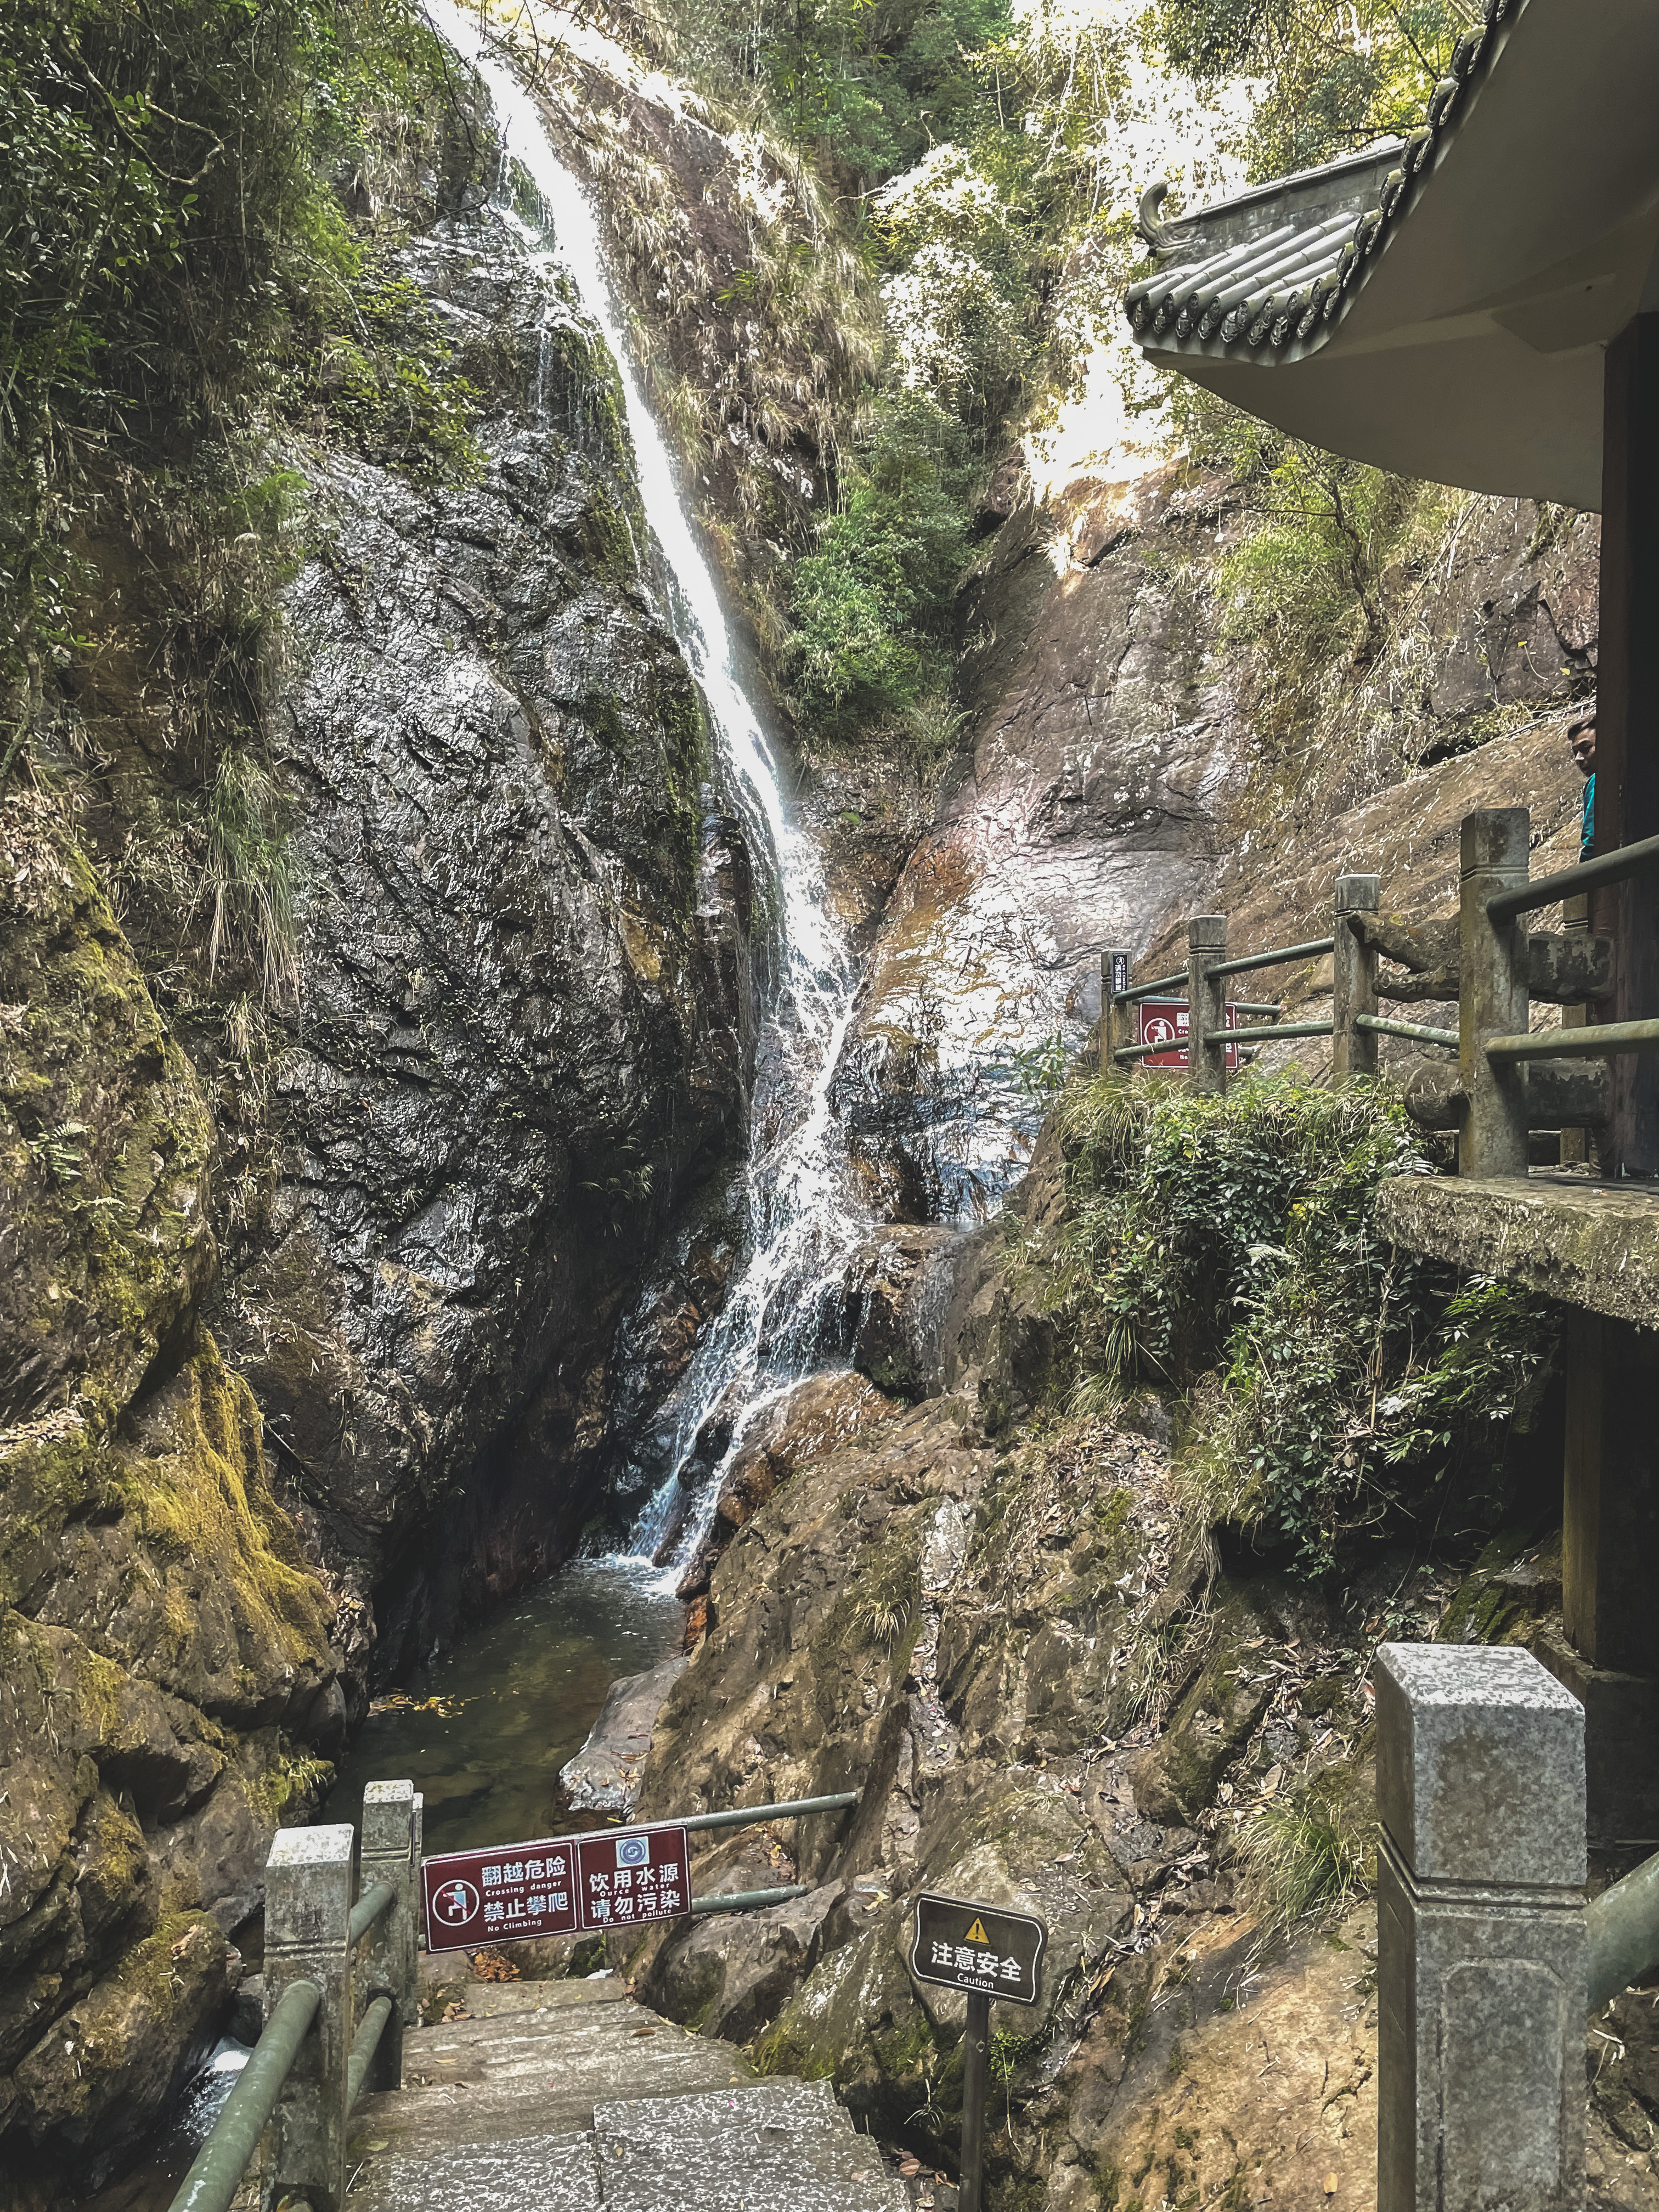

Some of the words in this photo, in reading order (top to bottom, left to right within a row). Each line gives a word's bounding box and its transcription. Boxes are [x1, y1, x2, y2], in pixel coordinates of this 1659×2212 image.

[481, 1855, 566, 1887] 翻越危险
[589, 1863, 679, 1892] 饮用水源
[486, 1886, 524, 1897] Crossing
[530, 1881, 561, 1890] danger
[591, 1889, 680, 1918] 请勿污染
[483, 1892, 568, 1922] 禁止攀爬
[642, 1909, 672, 1918] pollute
[503, 1920, 542, 1929] Climbing
[931, 1940, 1022, 1982] 注意安全
[957, 1973, 994, 1989] Caution
